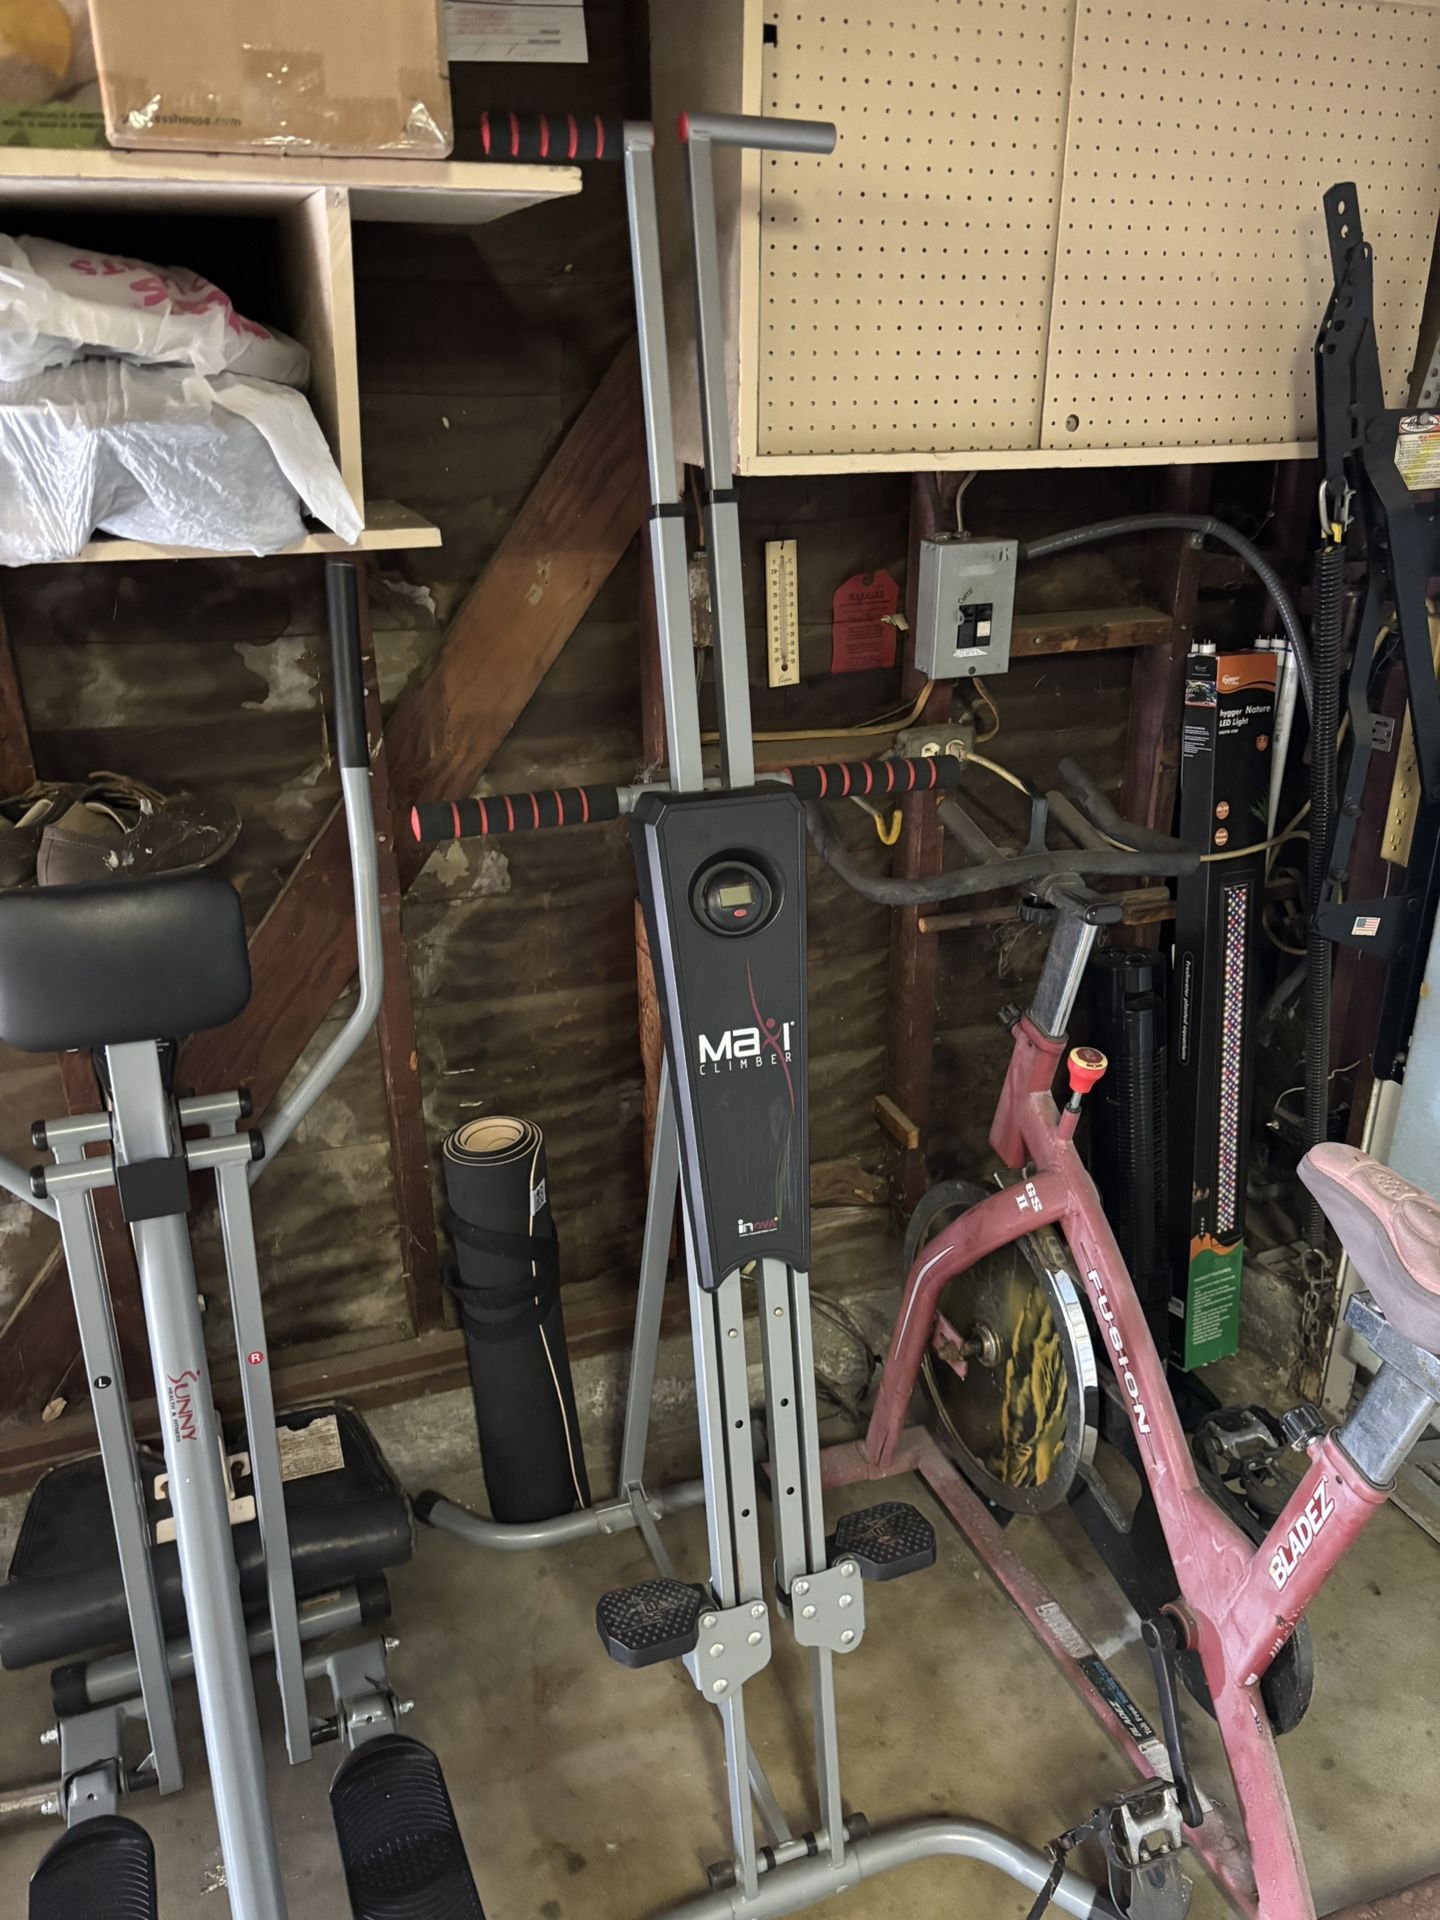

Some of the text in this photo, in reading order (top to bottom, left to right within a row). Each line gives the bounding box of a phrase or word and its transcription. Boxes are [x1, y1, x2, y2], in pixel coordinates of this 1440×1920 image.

[1219, 705, 1271, 718] hygger Nature
[1219, 717, 1249, 727] LED Light
[699, 1051, 791, 1076] CLIMBER
[1025, 1182, 1043, 1212] GS
[250, 1353, 261, 1363] R
[1086, 1268, 1151, 1434] FUSION
[98, 1377, 107, 1387] L
[166, 1369, 201, 1441] SUNNY
[168, 1387, 176, 1410] HEALTH
[173, 1419, 181, 1443] FITNESS
[1268, 1476, 1335, 1592] BLADEZ
[1107, 1698, 1142, 1737] BLADEZ
[1140, 1721, 1152, 1735] Toll
